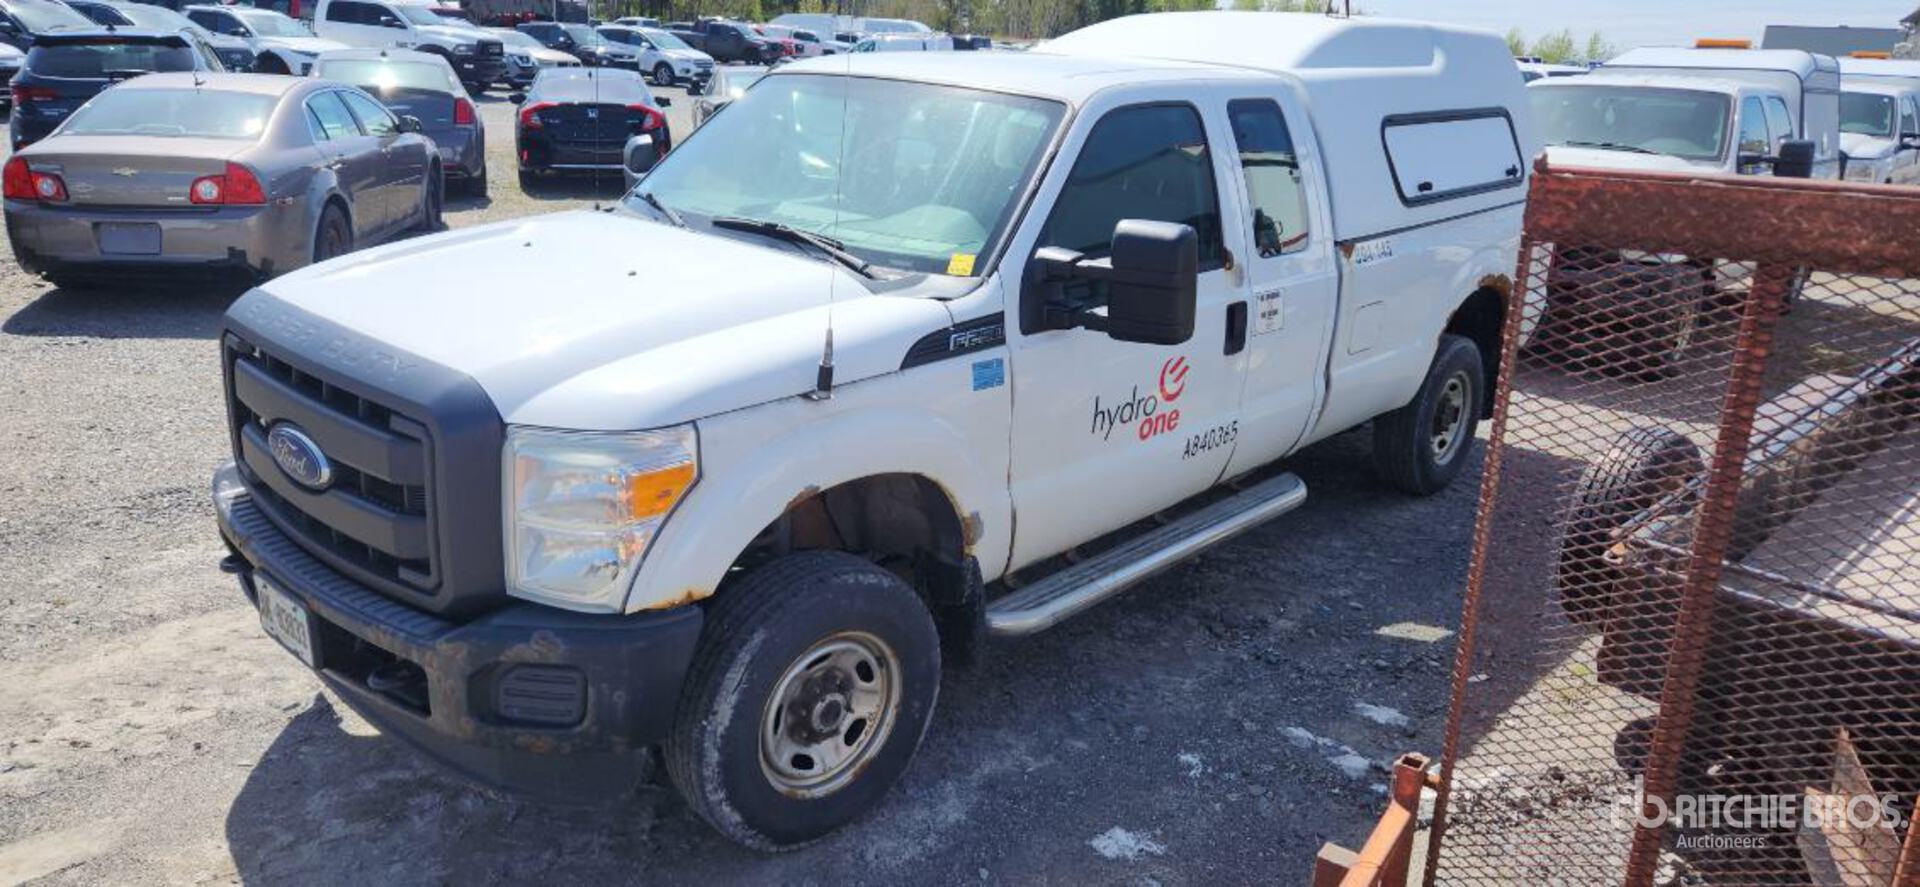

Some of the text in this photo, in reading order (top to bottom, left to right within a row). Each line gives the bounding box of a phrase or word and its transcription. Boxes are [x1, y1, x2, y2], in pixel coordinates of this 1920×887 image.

[325, 338, 417, 382] DUTY
[1092, 384, 1158, 441] hydro
[1139, 409, 1181, 441] one
[278, 436, 308, 476] Ford
